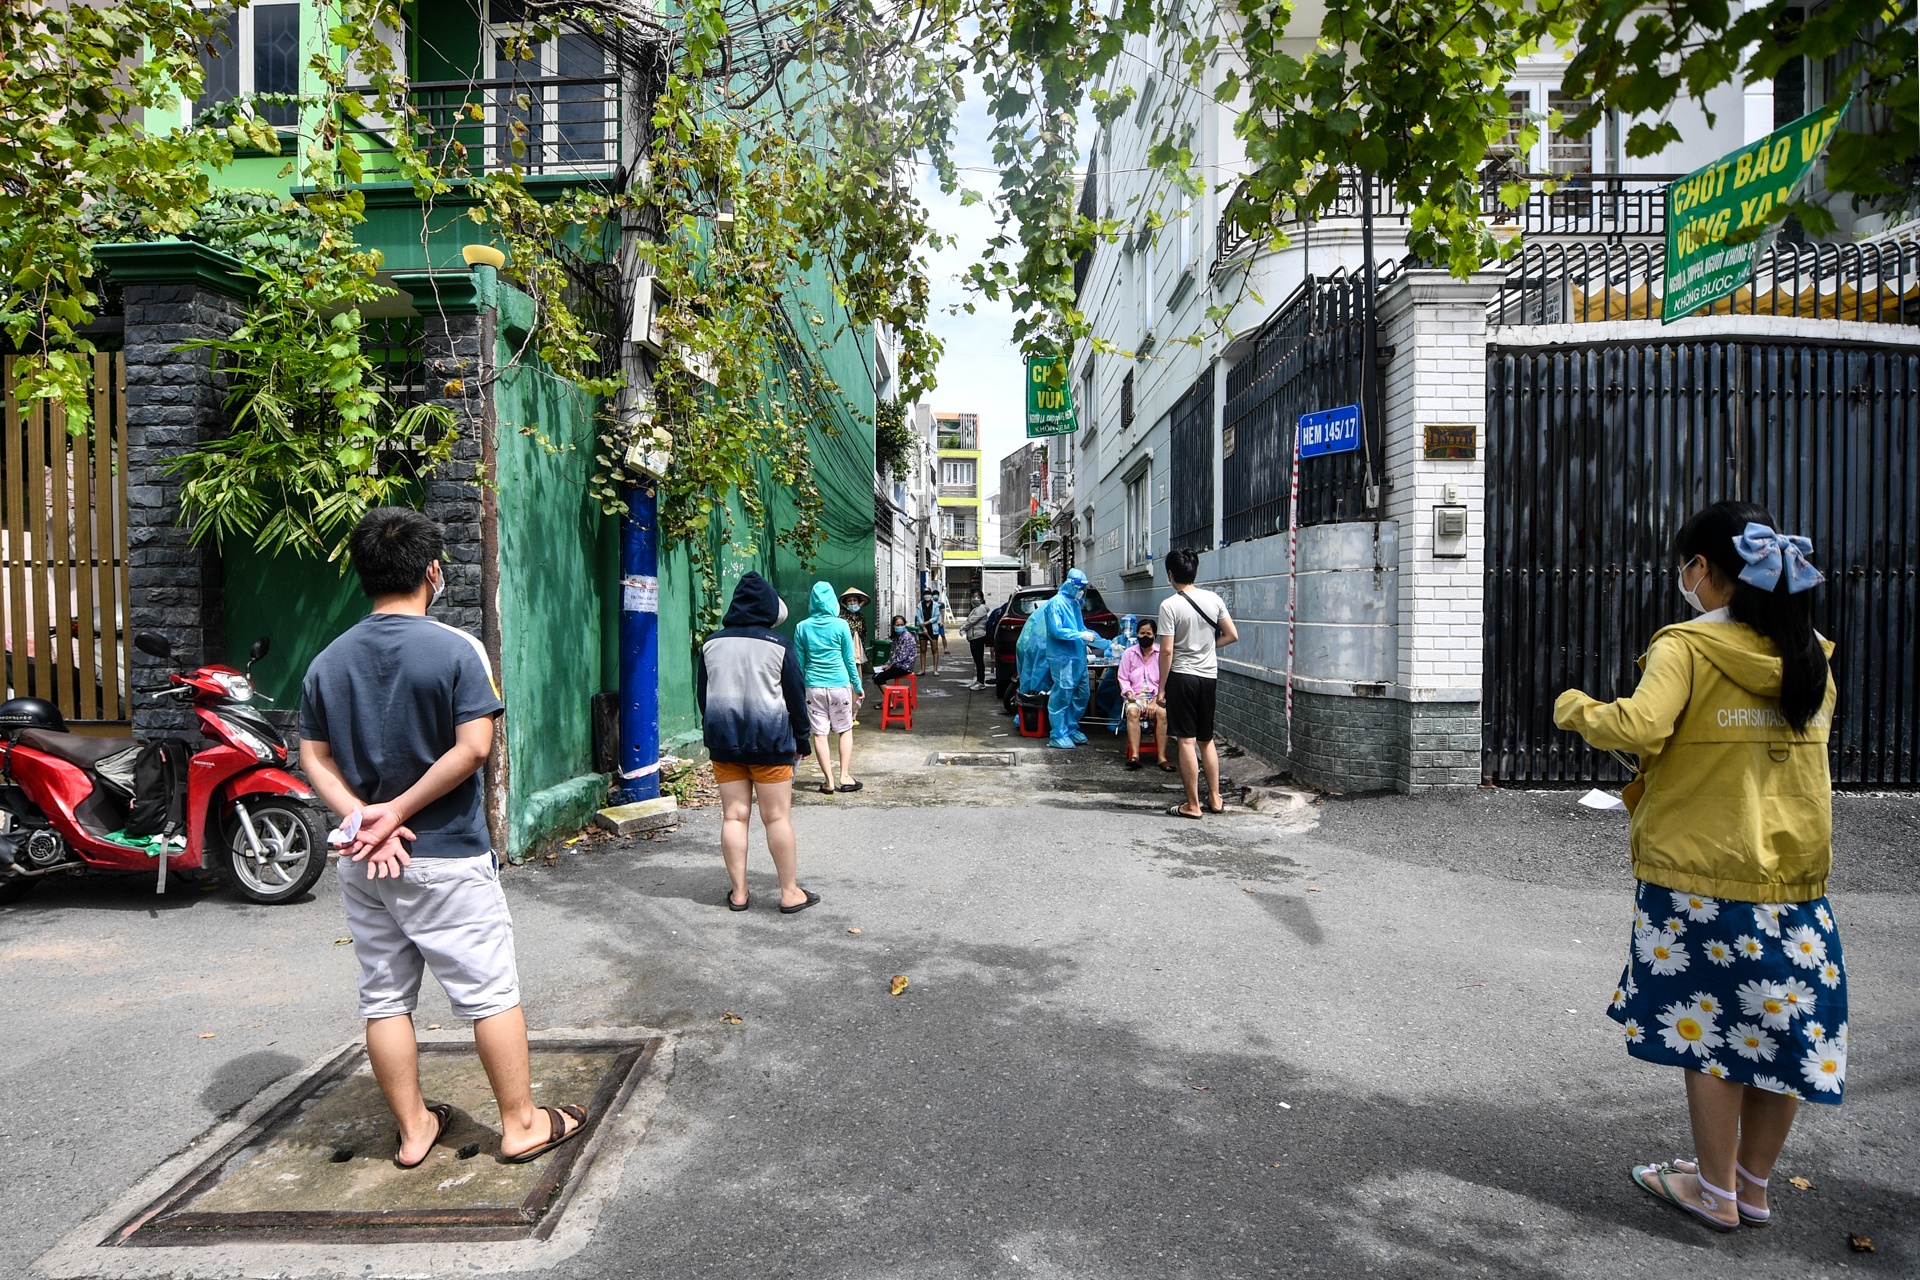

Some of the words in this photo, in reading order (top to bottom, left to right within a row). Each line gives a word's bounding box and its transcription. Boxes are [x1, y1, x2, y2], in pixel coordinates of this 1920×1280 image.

[1674, 156, 1730, 216] CHỐT
[1733, 133, 1791, 190] BẢO
[1677, 208, 1731, 260] VÙNG
[1674, 287, 1700, 312] KHÔNG
[1702, 274, 1733, 298] ĐƯỢC
[1303, 418, 1322, 446] HẺM
[1324, 417, 1356, 442] 145/17
[1717, 708, 1786, 727] CHRISMTAS
